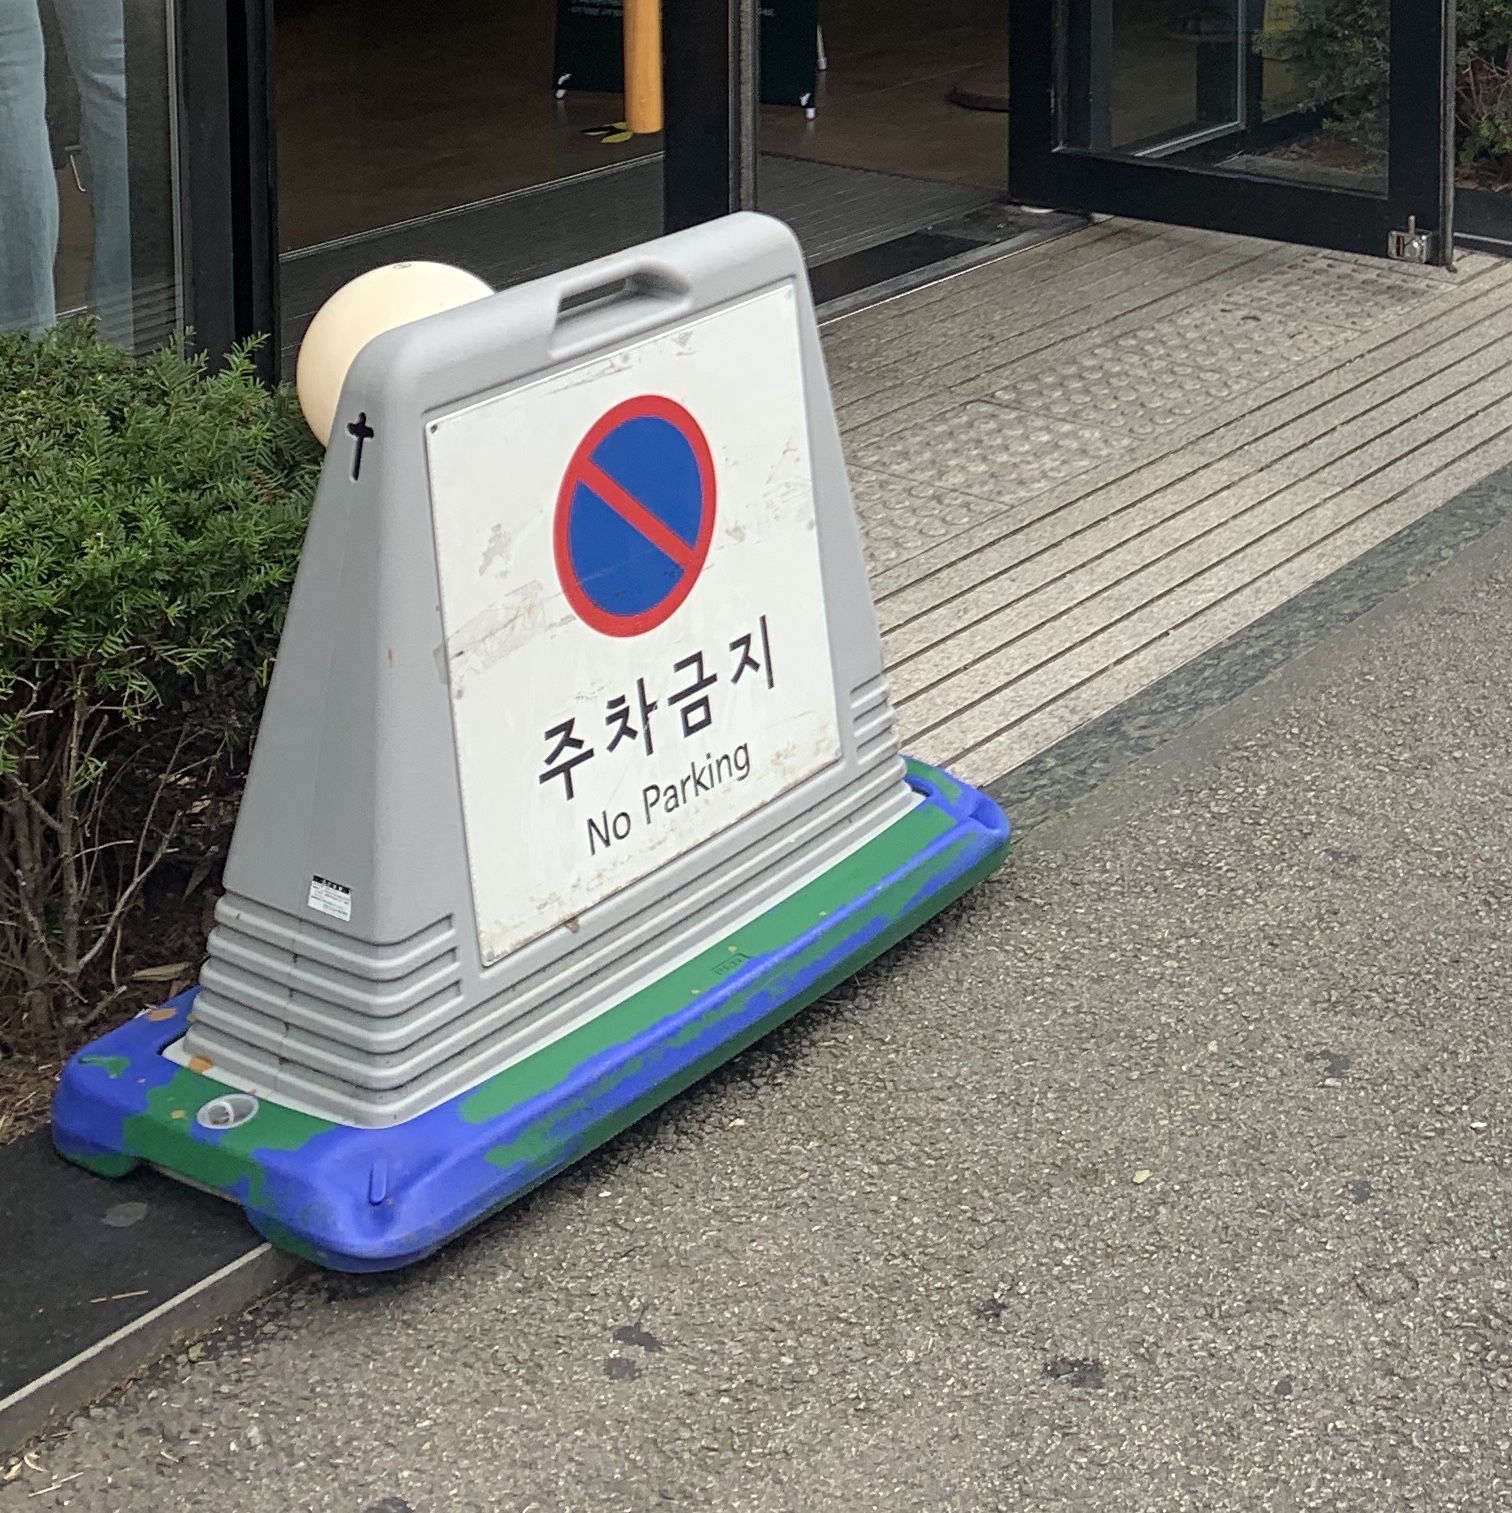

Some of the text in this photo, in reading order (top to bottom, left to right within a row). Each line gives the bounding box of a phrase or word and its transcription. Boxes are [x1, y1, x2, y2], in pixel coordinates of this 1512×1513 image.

[539, 614, 776, 801] 주차금지
[587, 741, 751, 856] No Parking
